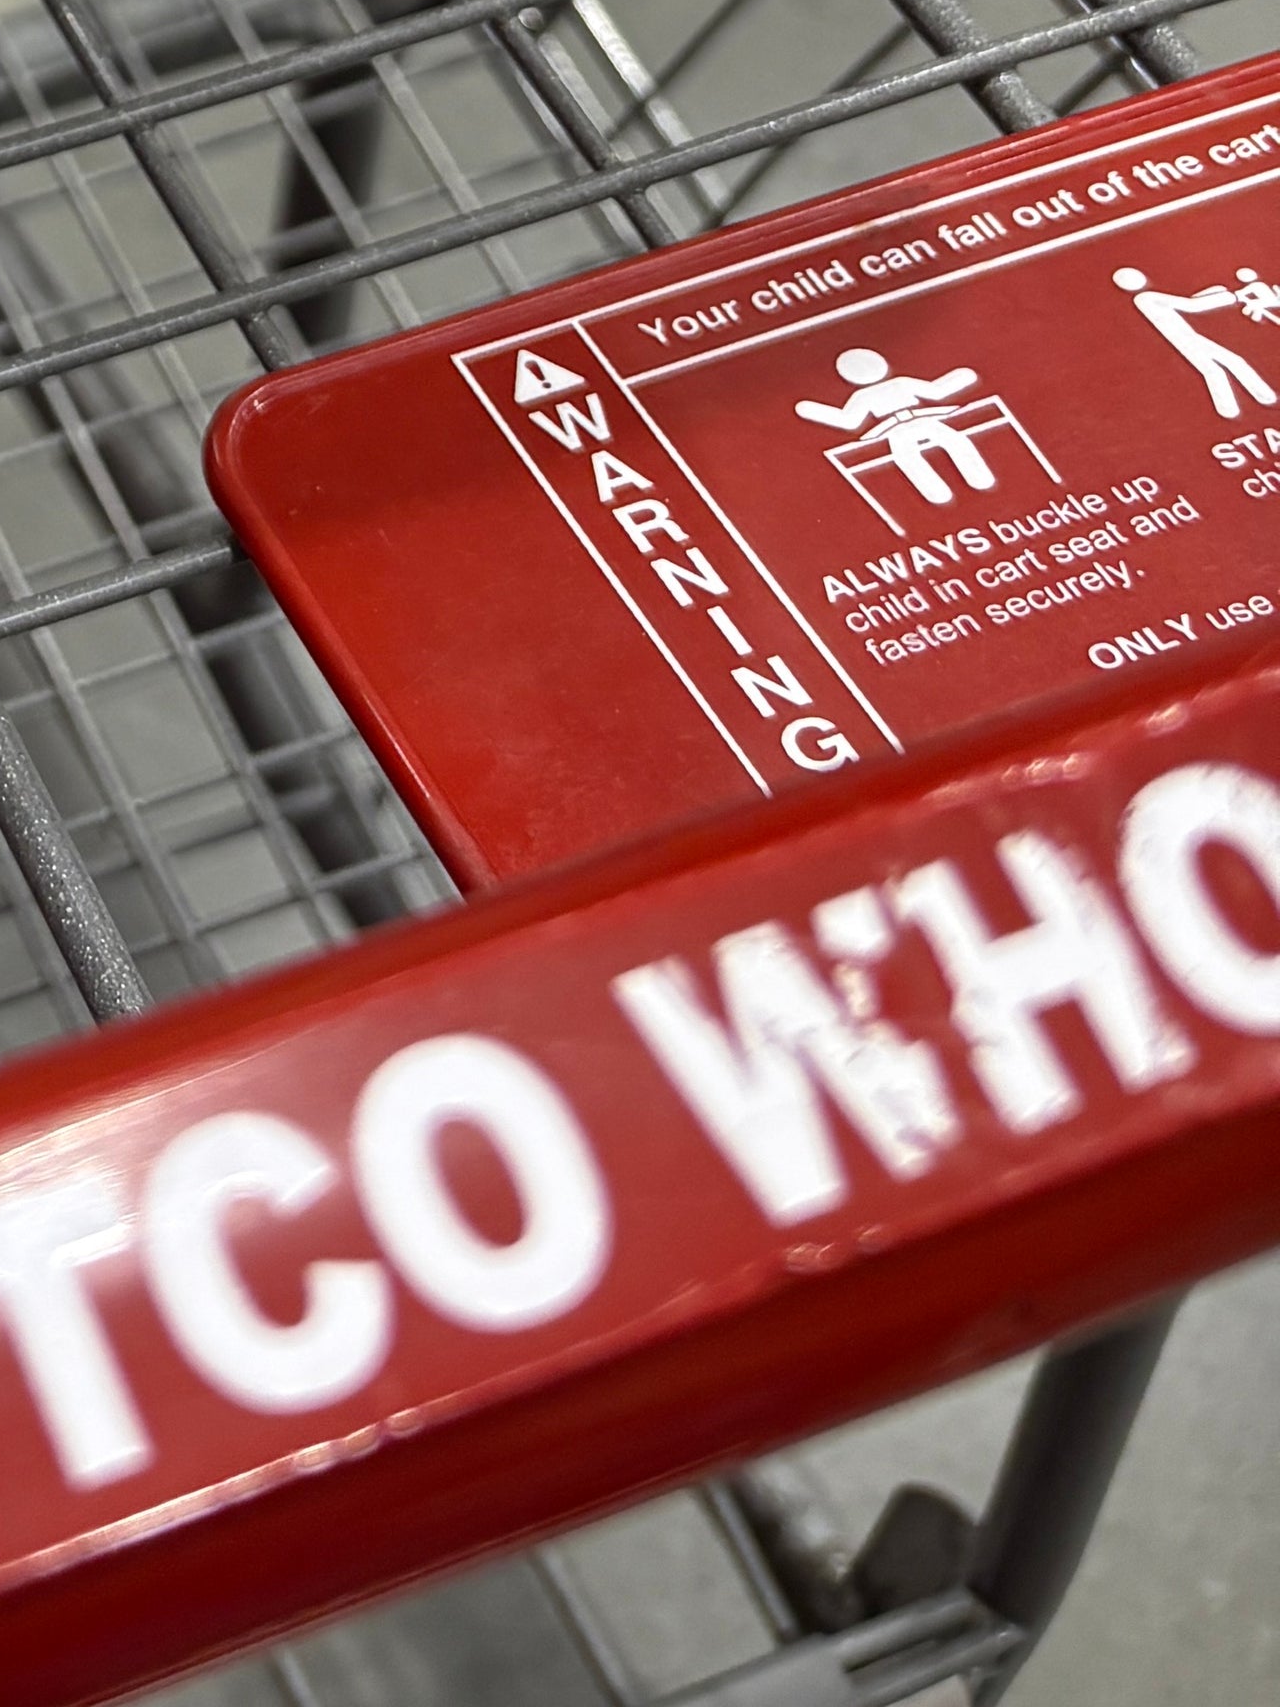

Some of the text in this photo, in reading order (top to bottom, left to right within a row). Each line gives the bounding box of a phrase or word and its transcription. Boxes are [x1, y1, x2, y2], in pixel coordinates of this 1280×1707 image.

[638, 293, 739, 347] Your
[750, 259, 856, 314] child
[860, 235, 937, 279] can
[938, 209, 1006, 254] fall
[1013, 188, 1088, 229] out
[1087, 165, 1138, 206] of
[1133, 149, 1204, 188] the
[529, 393, 860, 771] WARNING
[822, 475, 1160, 603] ALWAYS buckle up
[844, 495, 1200, 634] child in cart seat and
[865, 558, 1145, 667] fasten securely.
[1087, 595, 1274, 670] ONLY use
[610, 760, 1280, 1227] WHO
